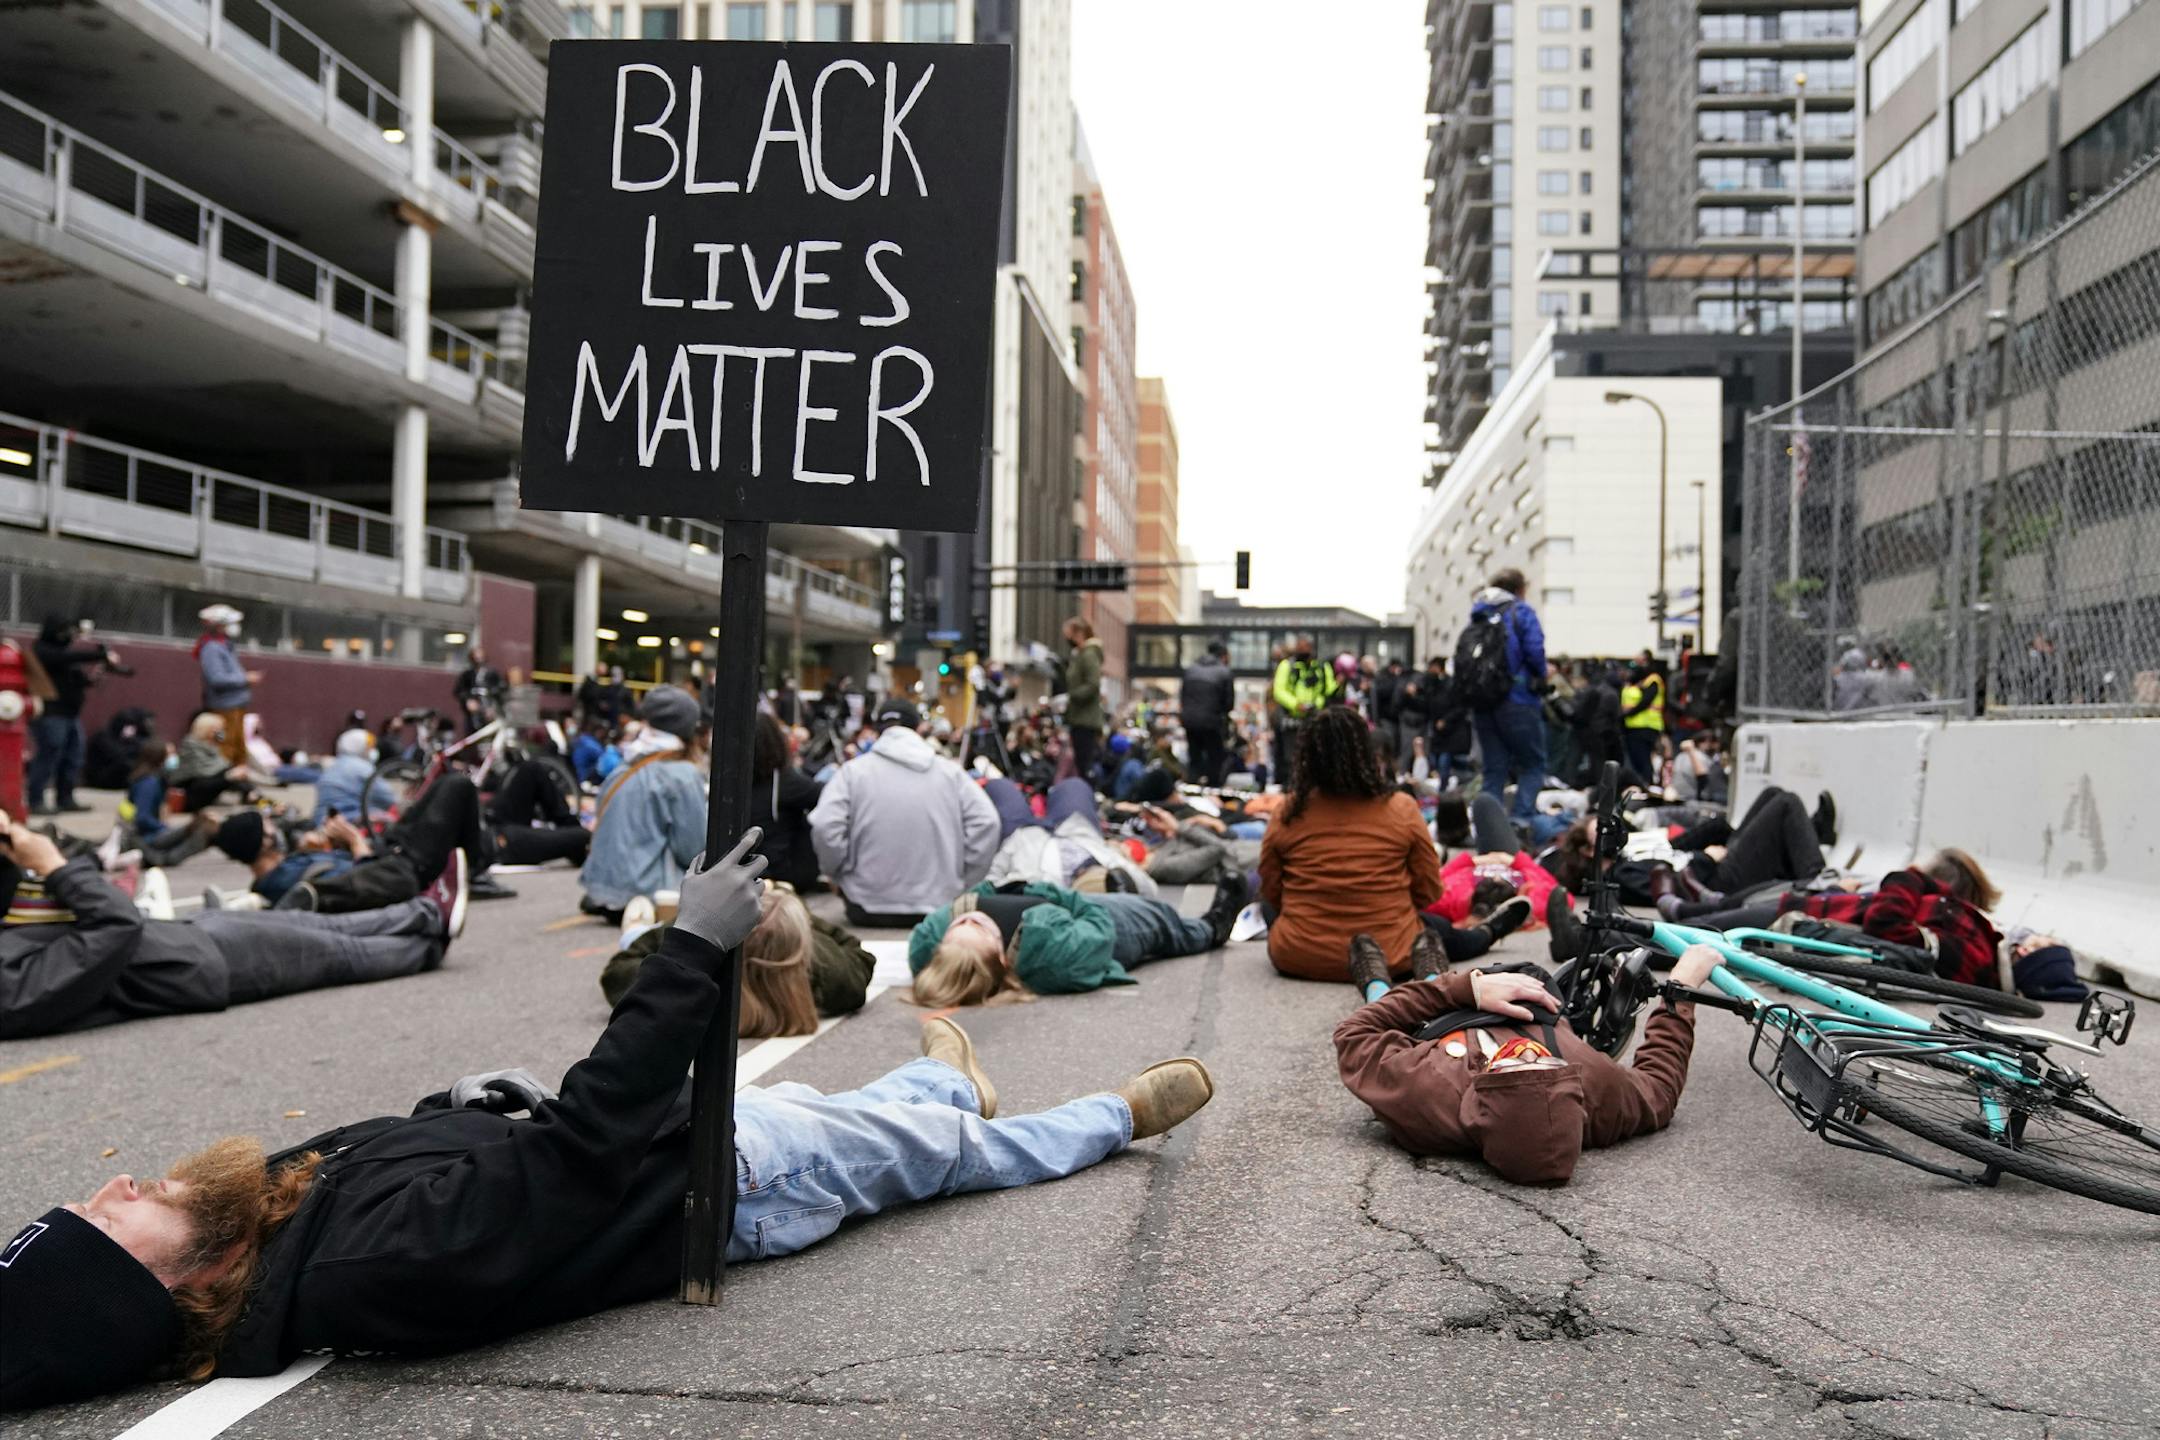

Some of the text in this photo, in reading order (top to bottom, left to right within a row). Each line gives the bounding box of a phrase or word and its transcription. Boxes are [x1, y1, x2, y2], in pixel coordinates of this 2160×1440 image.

[611, 59, 935, 201] BLACK
[641, 214, 911, 327] LIVES
[565, 340, 935, 486] MATTER
[889, 555, 905, 622] PARK
